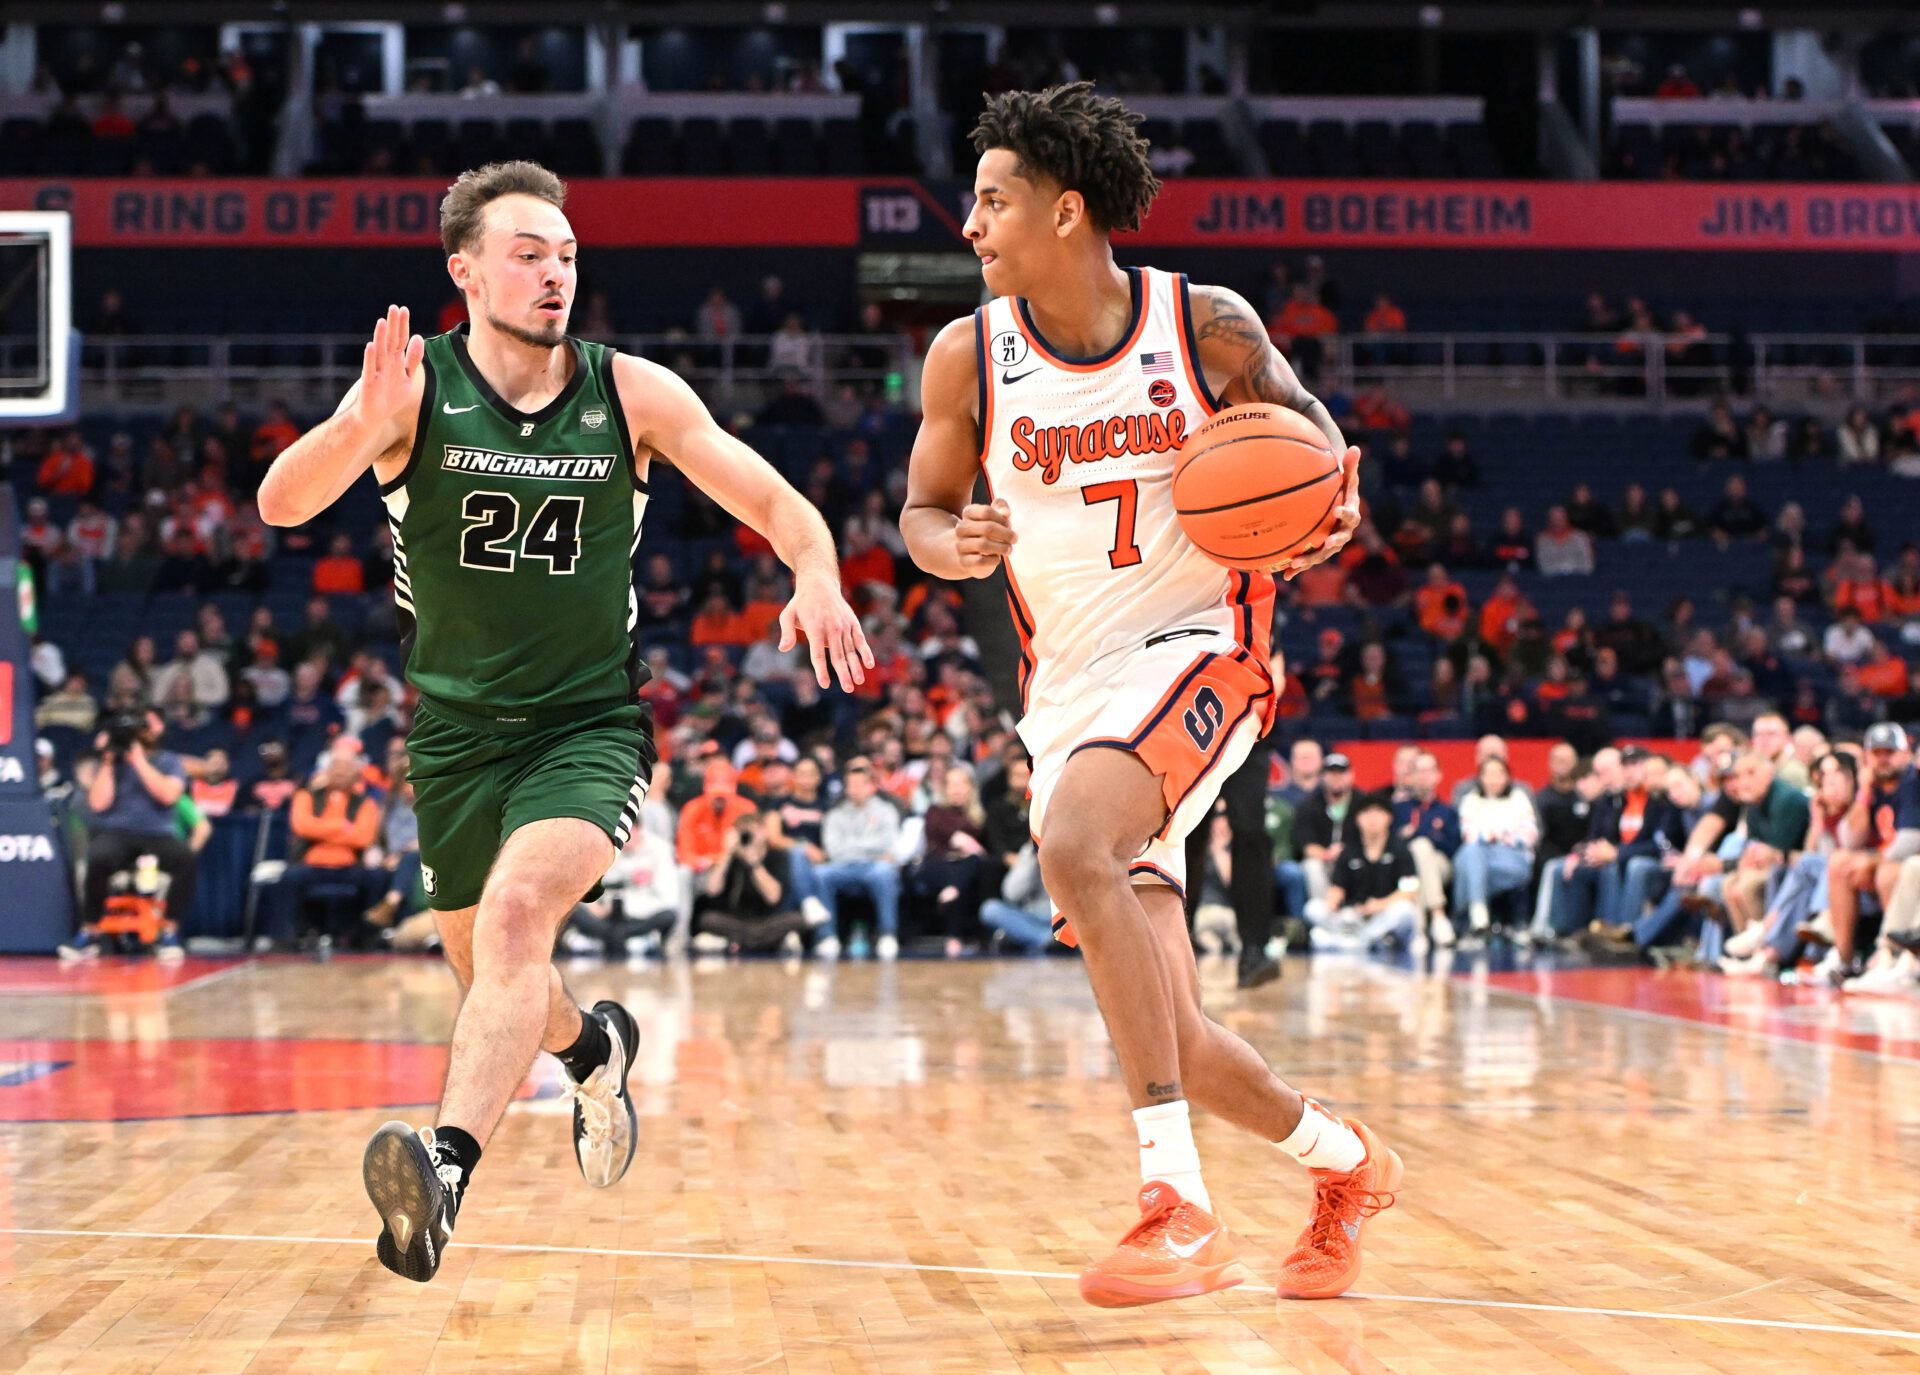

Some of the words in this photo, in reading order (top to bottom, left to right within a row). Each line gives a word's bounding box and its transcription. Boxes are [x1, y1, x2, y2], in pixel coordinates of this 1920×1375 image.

[112, 191, 248, 234] RING
[264, 191, 333, 234] OF
[354, 191, 447, 233] HO
[866, 195, 920, 232] 113
[1194, 193, 1286, 233] JIM
[1304, 193, 1532, 235] BOEHEIM
[1701, 195, 1788, 235] JIM
[1002, 336, 1015, 346] LM
[1003, 347, 1016, 362] 21
[520, 423, 535, 437] B
[1201, 412, 1271, 435] SYRACUSE
[446, 449, 610, 478] BINGHAMTON
[1011, 409, 1189, 485] Syracuse
[460, 490, 584, 575] 24
[1080, 479, 1142, 569] 7
[1183, 685, 1224, 752] S
